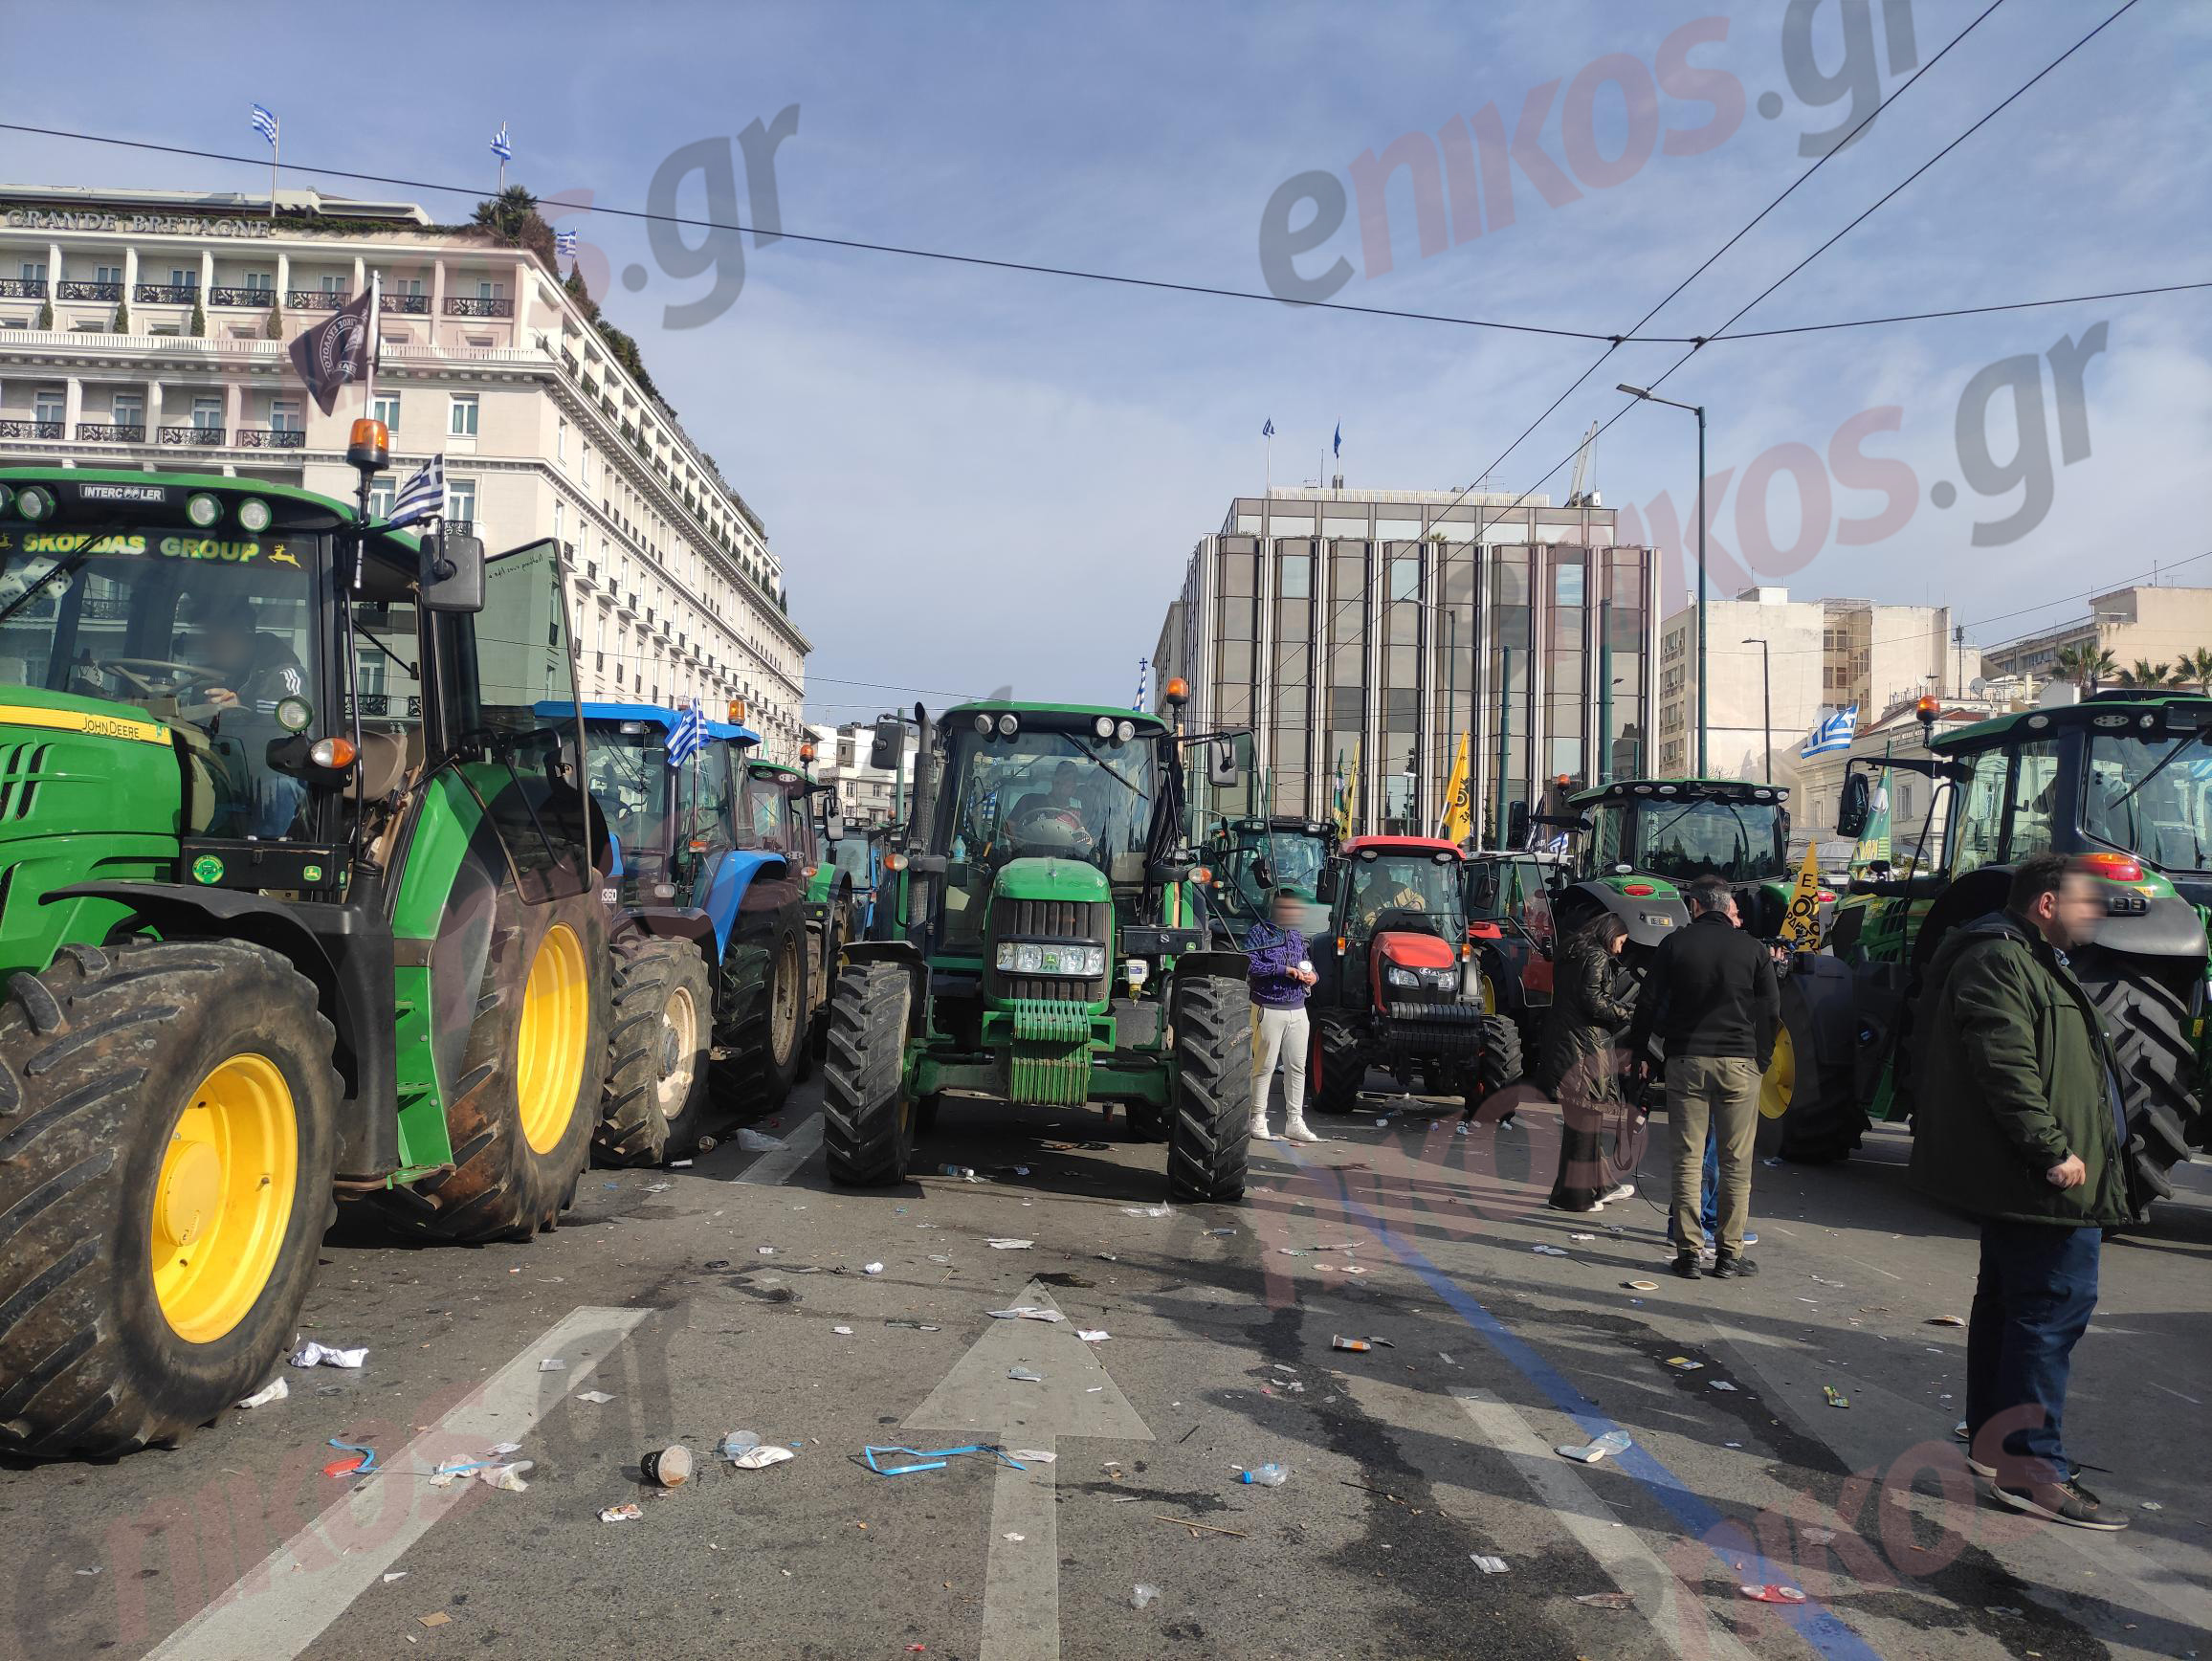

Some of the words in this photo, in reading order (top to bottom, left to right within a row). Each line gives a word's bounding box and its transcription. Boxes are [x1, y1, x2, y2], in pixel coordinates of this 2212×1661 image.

[6, 210, 117, 231] GRANDE
[132, 214, 270, 238] BRETAGNE
[160, 536, 260, 562] GROUP
[82, 717, 108, 733] JOHN
[109, 720, 140, 739] DEERE
[601, 888, 617, 901] 360
